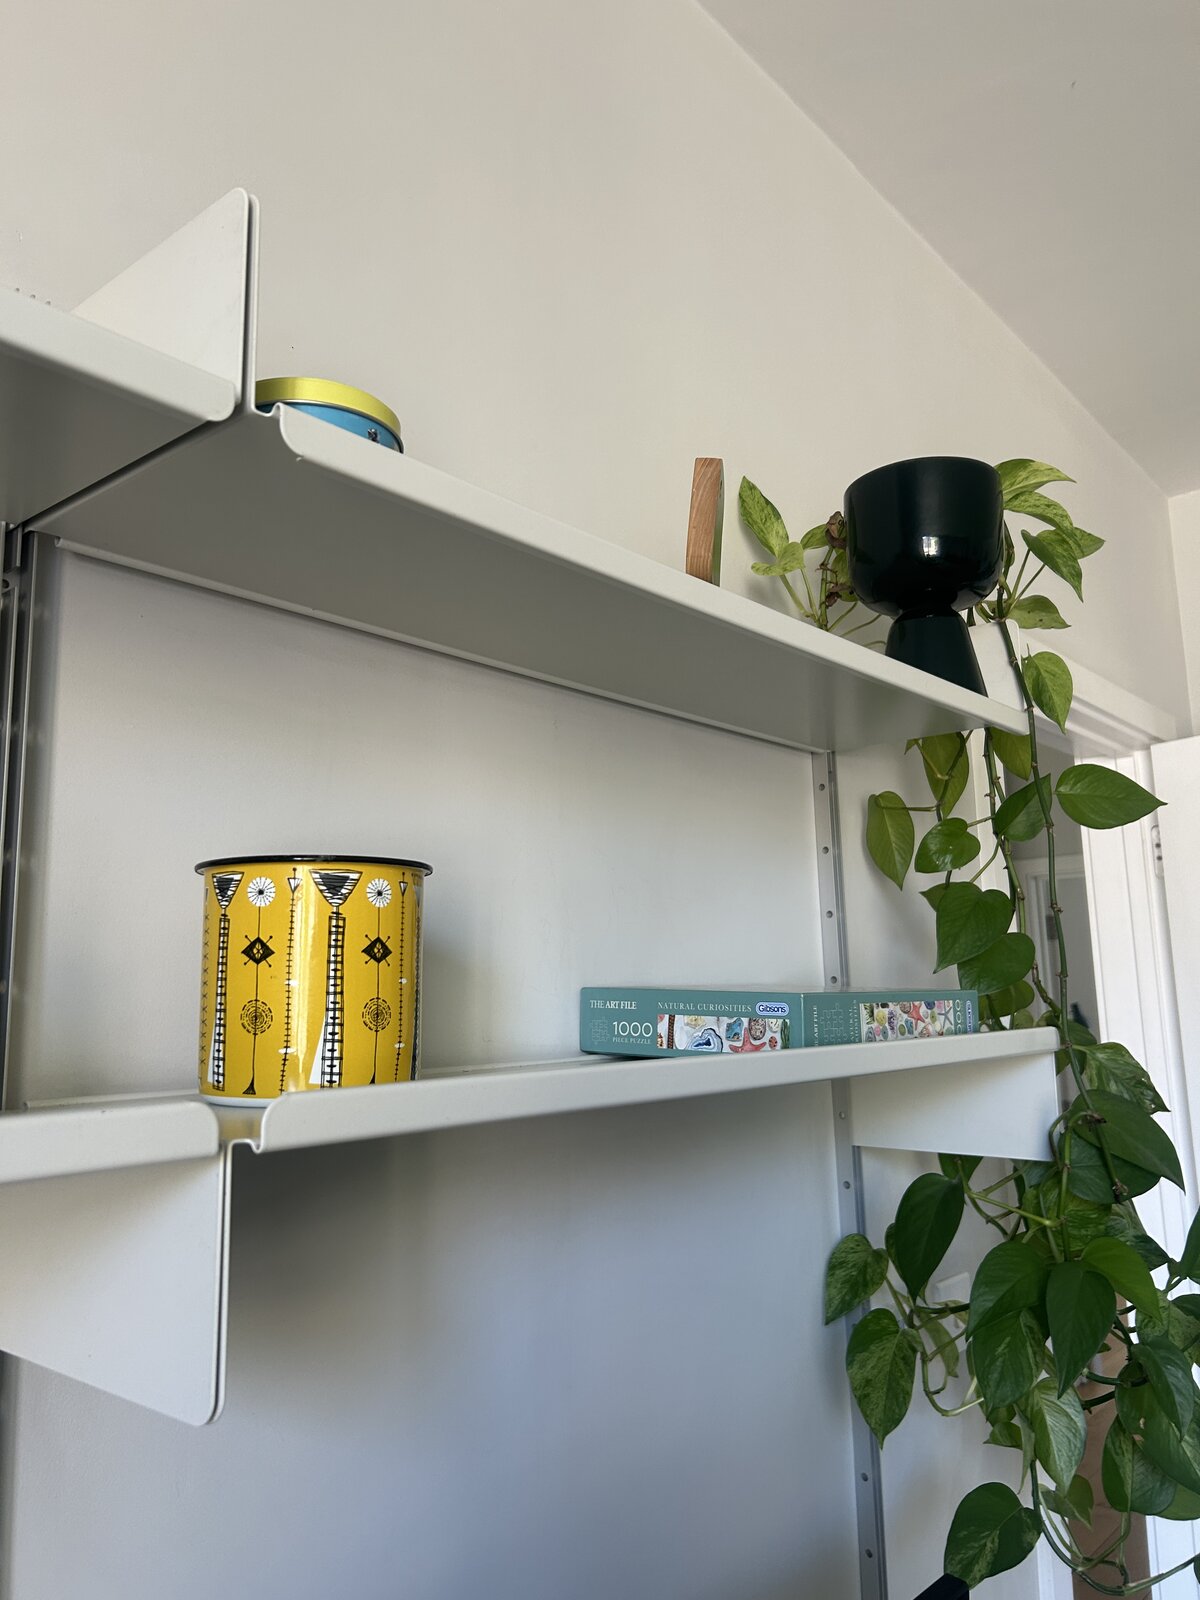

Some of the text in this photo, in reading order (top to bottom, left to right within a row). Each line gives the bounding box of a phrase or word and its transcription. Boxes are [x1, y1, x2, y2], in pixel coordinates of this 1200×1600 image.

[589, 999, 637, 1009] THE ART FILE
[657, 1002, 752, 1013] NATURAL CURIOSITIES
[758, 1004, 786, 1013] Gibsons
[612, 1021, 653, 1037] 1000
